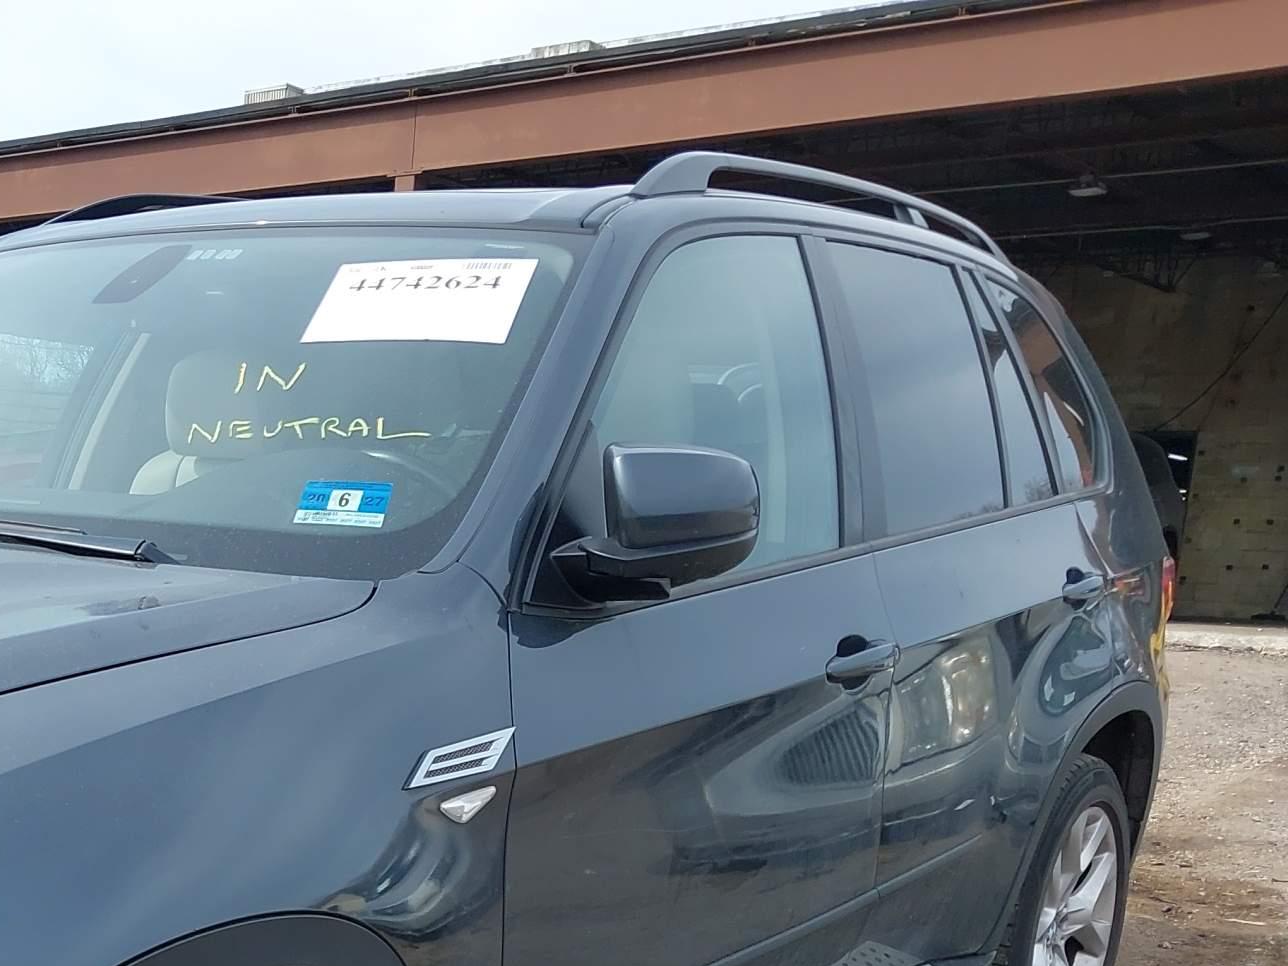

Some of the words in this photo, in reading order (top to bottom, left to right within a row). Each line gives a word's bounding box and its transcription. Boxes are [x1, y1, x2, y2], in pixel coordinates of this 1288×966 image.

[348, 275, 503, 292] 44742624
[234, 362, 307, 394] IN
[187, 417, 432, 443] NEUTRAL
[338, 492, 352, 507] 6
[364, 496, 386, 506] 27
